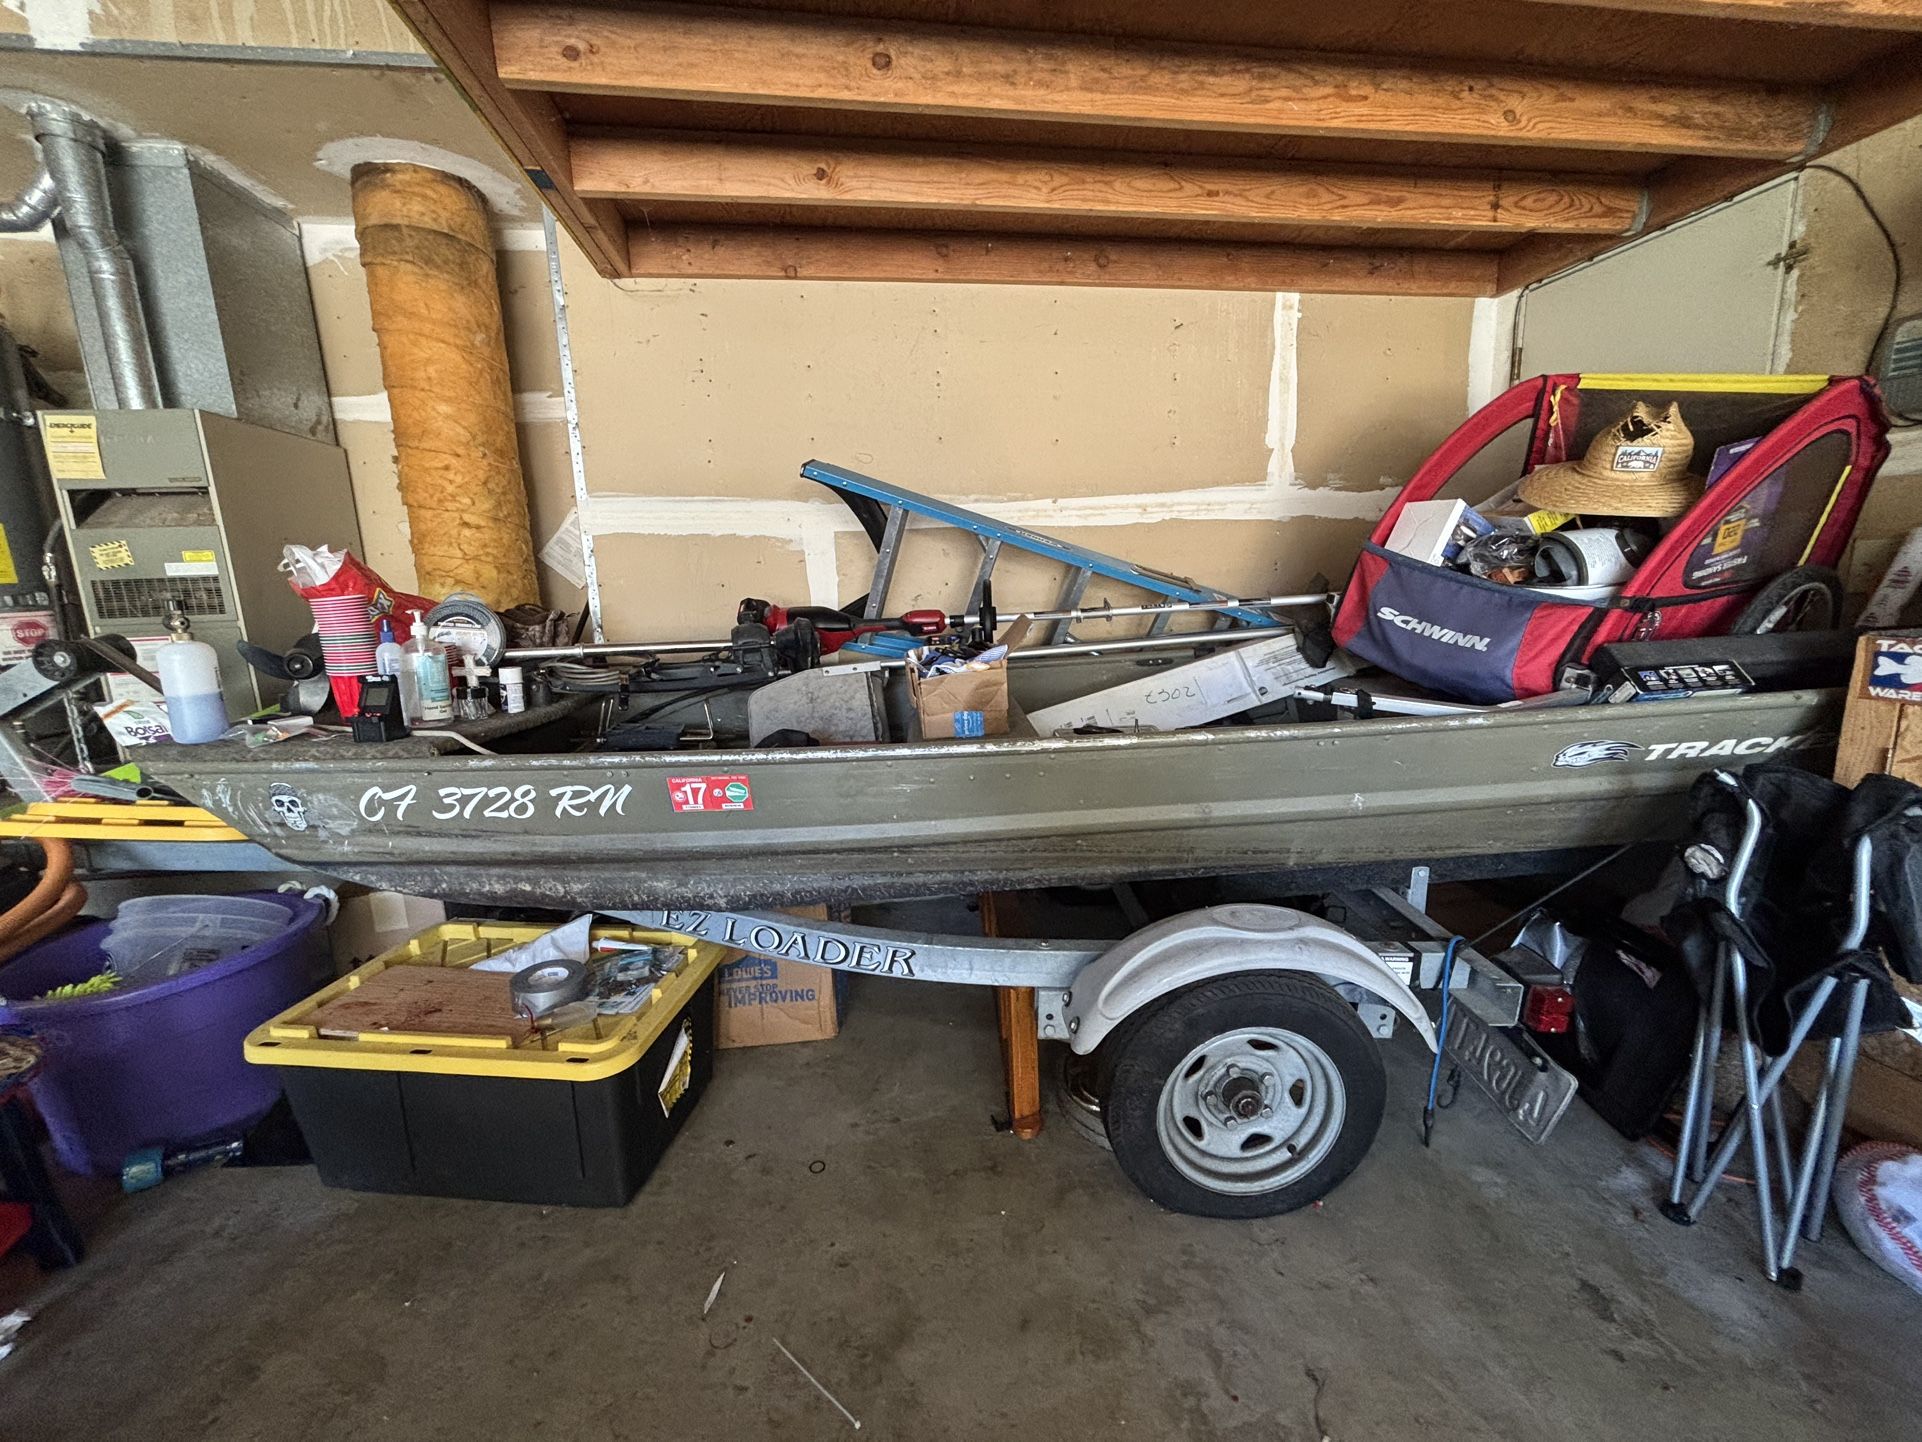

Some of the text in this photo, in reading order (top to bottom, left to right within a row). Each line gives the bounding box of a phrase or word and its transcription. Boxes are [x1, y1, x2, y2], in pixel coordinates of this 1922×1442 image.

[1618, 454, 1657, 464] CALIFORNIA
[15, 628, 45, 639] STOP
[1376, 606, 1491, 652] SCHWINN
[432, 784, 536, 820] 3728
[549, 783, 633, 819] RN
[680, 782, 707, 805] 17
[660, 910, 918, 978] EZ LOADER
[724, 963, 772, 979] LOWE'S
[728, 988, 817, 1009] IMPROVING
[753, 983, 778, 993] STOP
